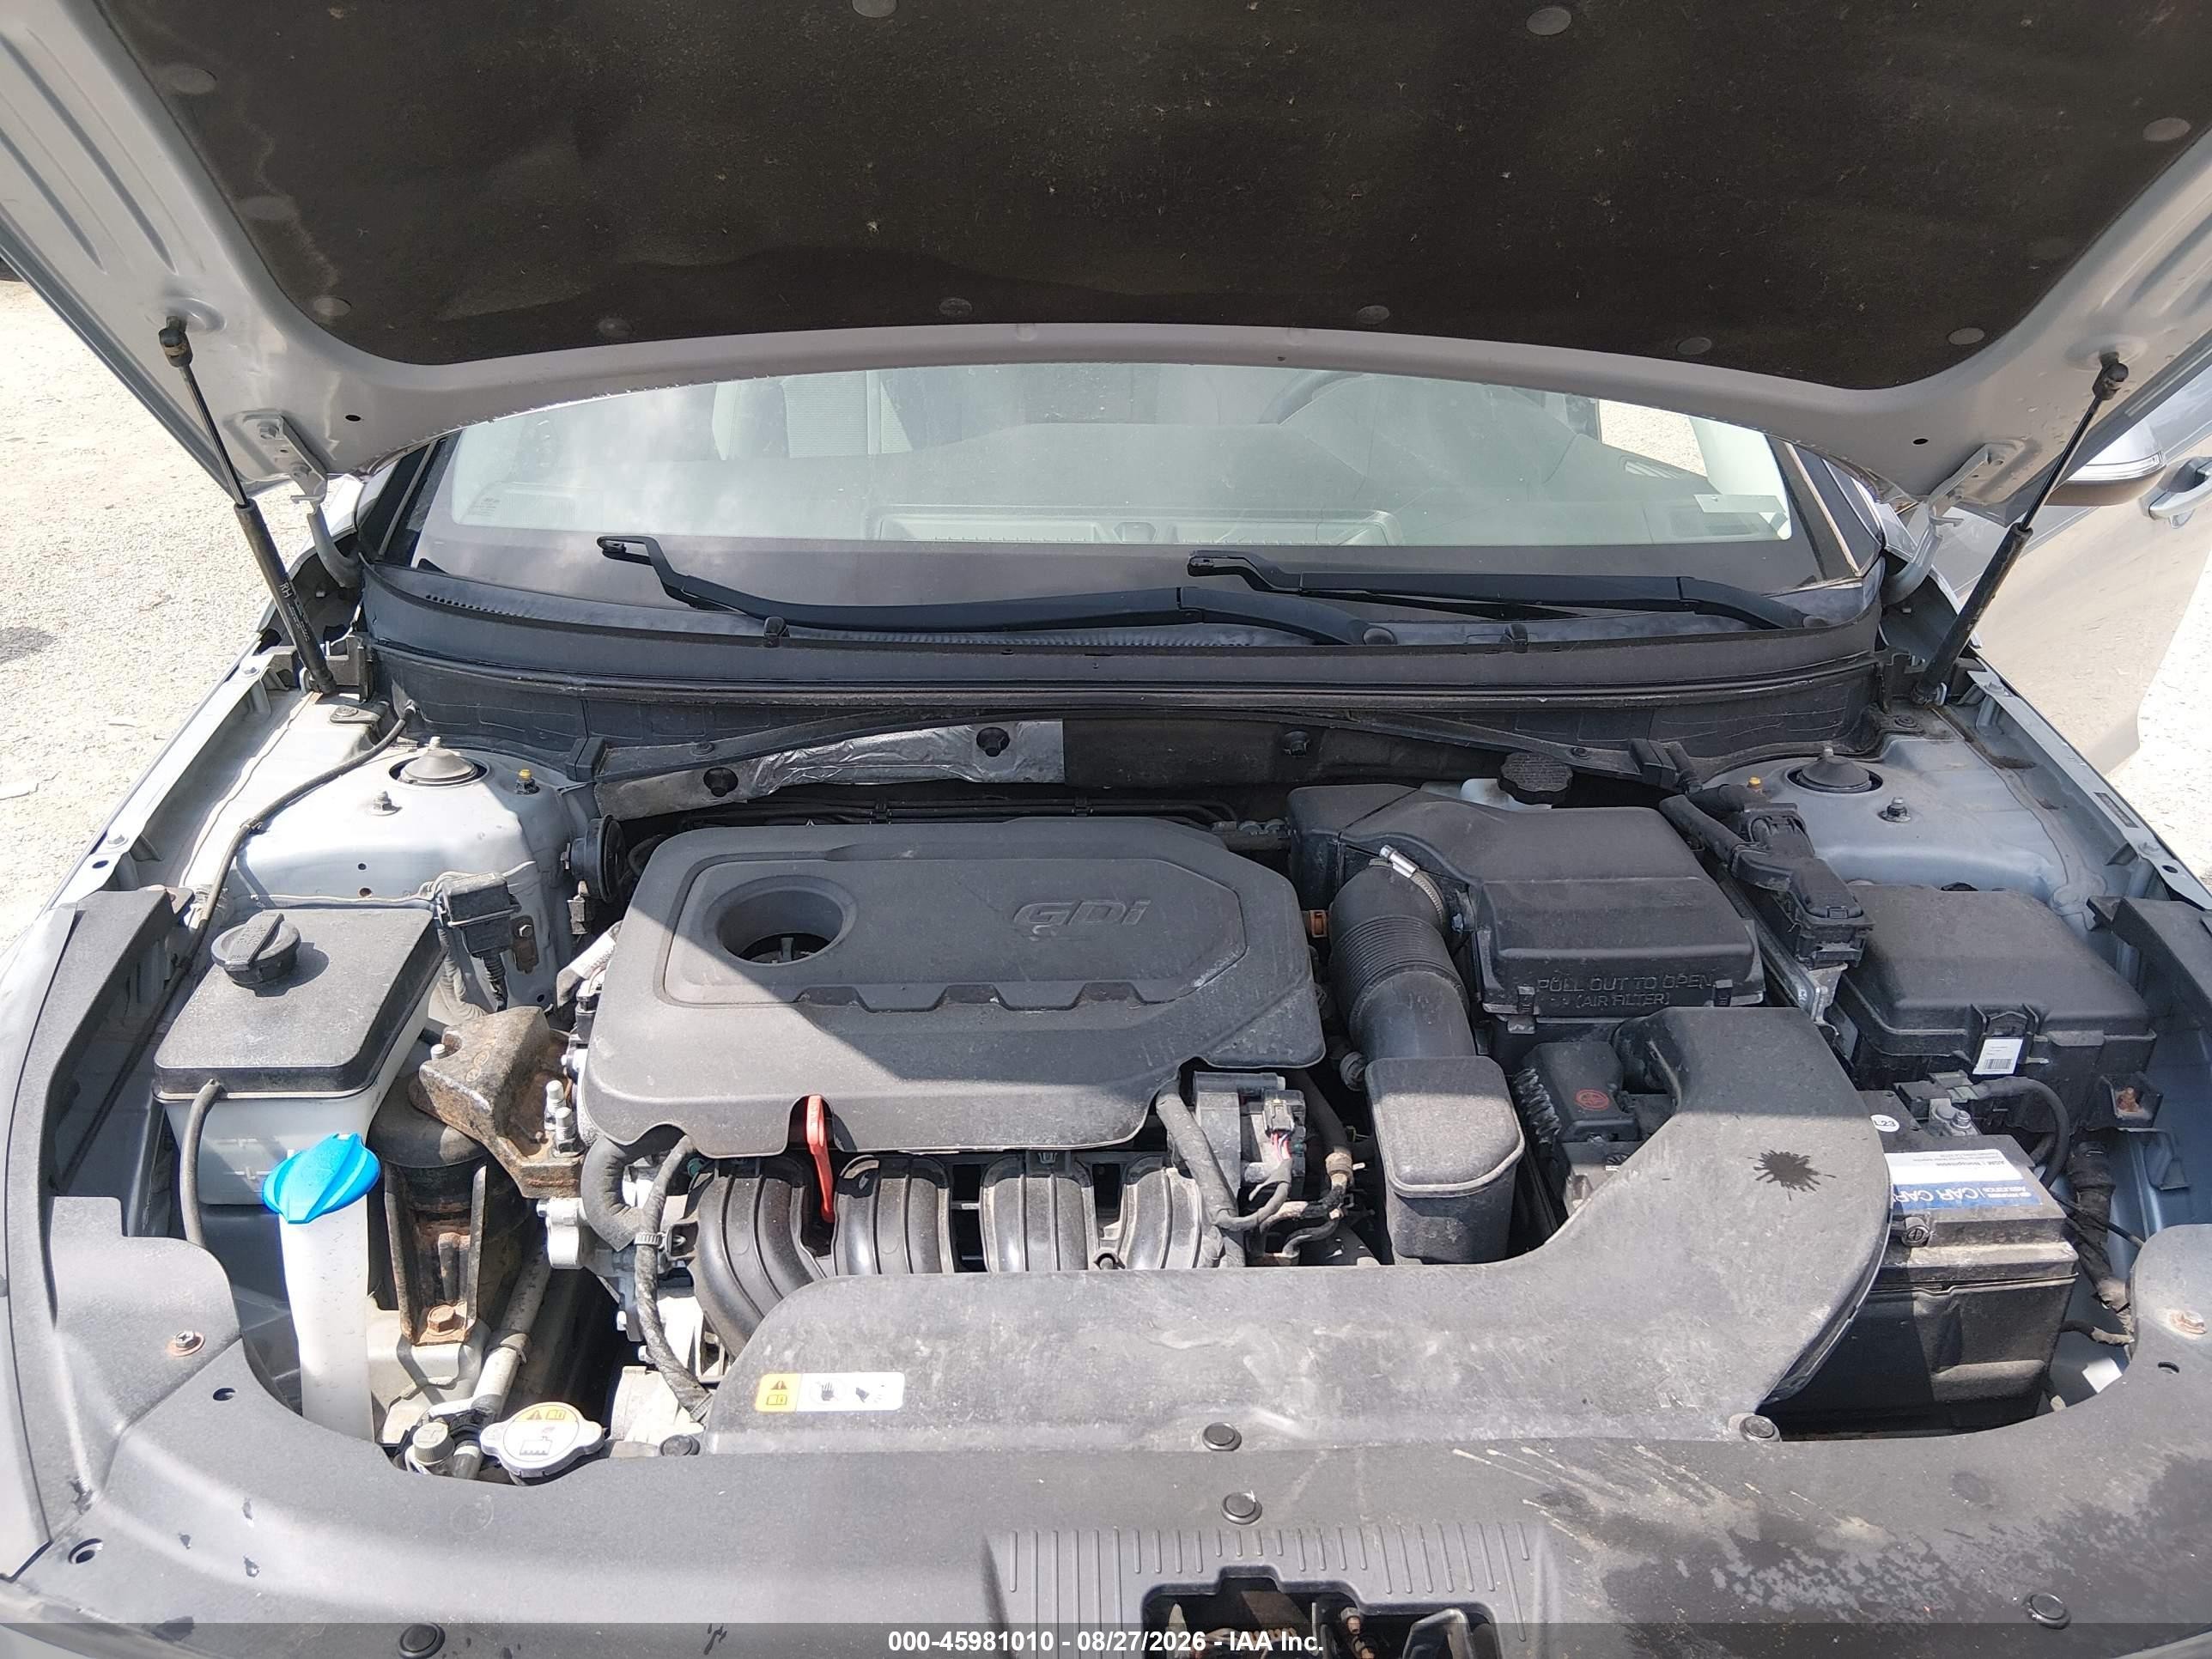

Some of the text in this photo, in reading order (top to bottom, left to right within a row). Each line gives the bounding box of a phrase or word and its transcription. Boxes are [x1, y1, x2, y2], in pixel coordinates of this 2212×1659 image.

[280, 583, 293, 598] RH
[1537, 974, 1716, 993] PULL OUT TO OPEN
[1892, 1187, 1979, 1203] CAR CAR
